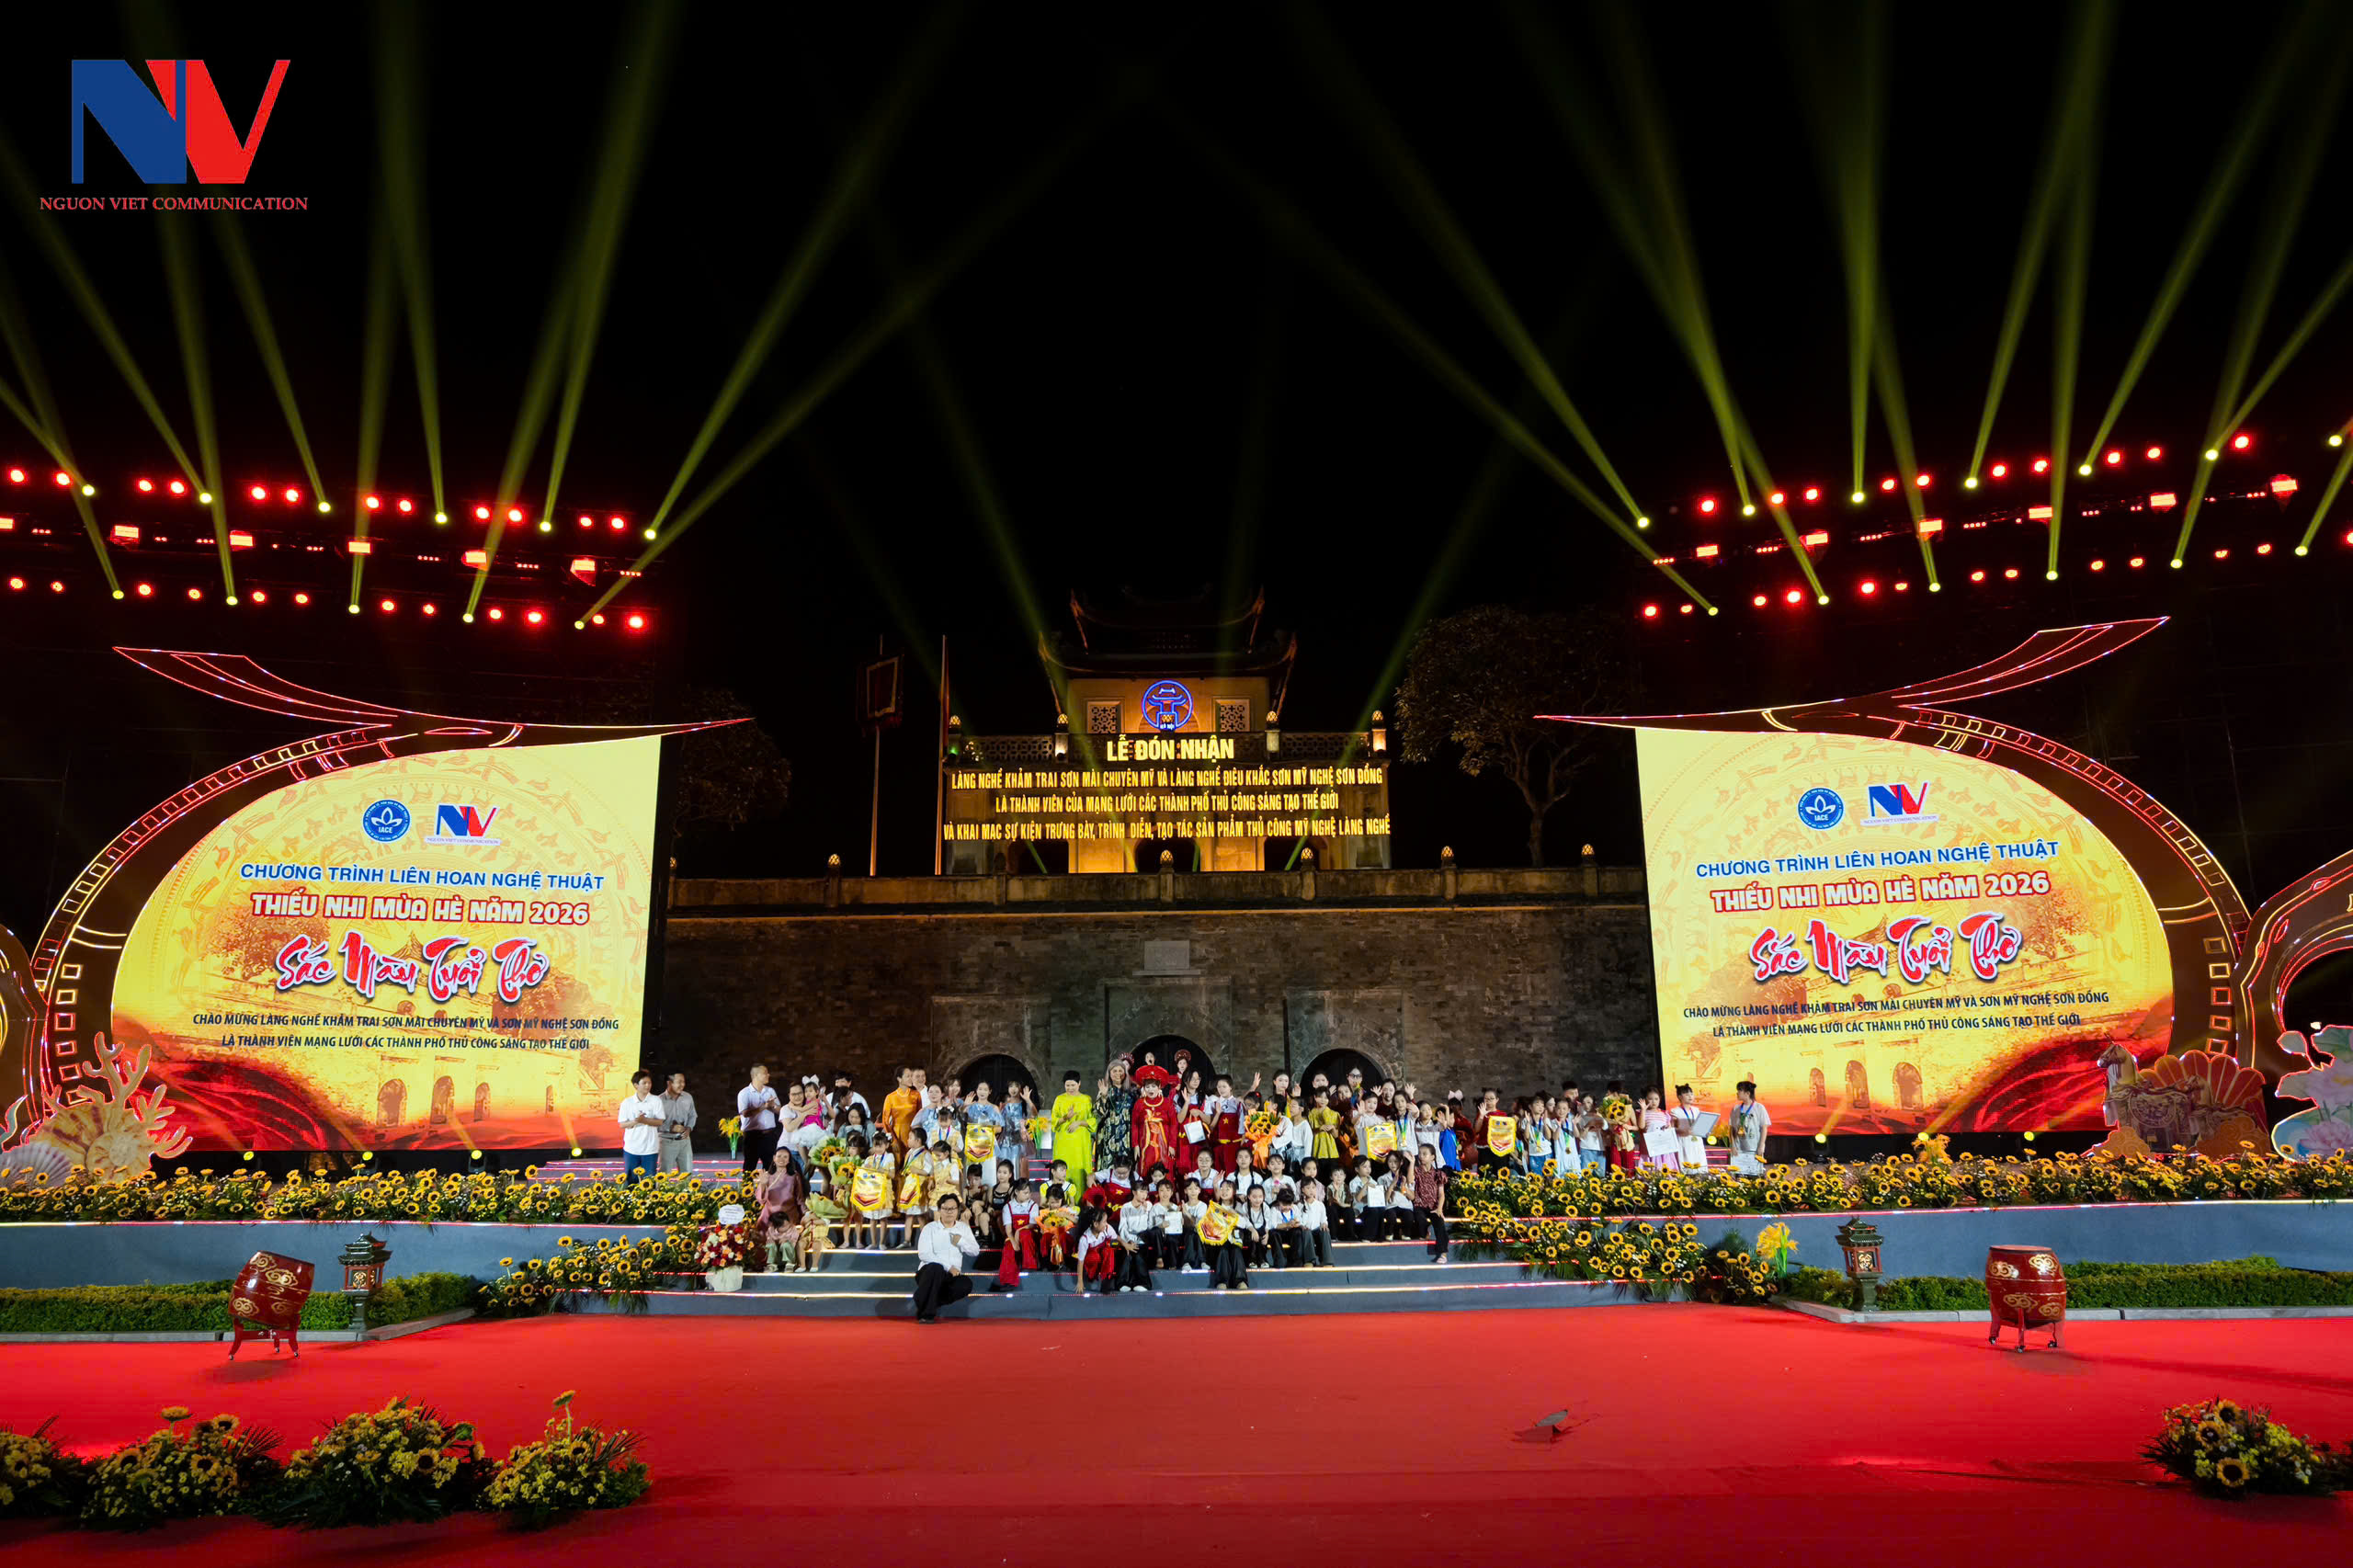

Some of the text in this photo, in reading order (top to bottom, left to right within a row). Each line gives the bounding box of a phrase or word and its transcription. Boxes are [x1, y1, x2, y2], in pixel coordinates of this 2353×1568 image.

[1107, 734, 1234, 763] LỄ ĐÓN NHẬN
[952, 763, 1382, 789] LÀNG NGHỀ KHẢM TRAI SƠN MÀI CHUYÊN MỸ VÀ LÀNG NGHỀ ĐIÊU KHẮC SƠN MỸ NGHỆ SƠN ĐỒNG
[996, 788, 1338, 814] LÀ THÀNH VIÊN CỦA MẠNG LƯỚI CÁC THÀNH PHỐ THỦ CÔNG SÁNG TẠO THẾ GIỚI
[1869, 782, 1927, 816] NV
[437, 805, 497, 836] NV
[944, 821, 954, 840] VÀ
[957, 824, 979, 840] KHAI
[1005, 822, 1018, 842] SỰ
[1020, 821, 1041, 842] KIỆN
[1046, 823, 1075, 840] TRƯNG
[1078, 820, 1096, 840] BÀY,
[1098, 820, 1125, 839] TRÌNH
[1130, 817, 1154, 839] DIỄN,
[1157, 822, 1173, 841] TẠO
[1176, 819, 1193, 838] TÁC
[1196, 816, 1214, 837] SẢN
[1218, 814, 1244, 837] PHẨM
[1246, 816, 1264, 836] THỦ
[1267, 818, 1291, 836] CÔNG
[1295, 818, 1308, 836] MỸ
[1313, 816, 1336, 837] NGHỆ
[1339, 816, 1363, 835] LÀNG
[1366, 813, 1390, 835] NGHỀ
[1696, 839, 2059, 877] CHƯƠNG TRÌNH LIÊN HOAN NGHỆ THUẬT
[241, 863, 604, 892] CHƯƠNG TRÌNH LIÊN HOAN NGHỆ THUẬT
[1711, 871, 2051, 913] THIẾU NHI MÙA HÈ NĂM 2026
[251, 887, 589, 925] THIẾU NHI MÙA HÈ NĂM 2026
[277, 934, 336, 989] Sắc
[1750, 926, 1808, 981] Sắc
[1684, 990, 2109, 1017] CHÀO MỪNG LÀNG NGHỀ KHẢM TRAI SƠN MÀI CHUYÊN MỸ VÀ SƠN MỸ NGHỆ SƠN ĐỒNG
[193, 1013, 619, 1031] CHÀO MỪNG LÀNG NGHỀ KHẢM TRAI SƠN MÀI CHUYÊN MỸ VÀ SƠN MỸ NGHỆ SƠN ĐỒNG
[1713, 1012, 2081, 1037] LÀ THÀNH VIÊN MẠNG LƯỚI CÁC THÀNH PHỐ THỦ CÔNG SÁNG TẠO THẾ GIỚI
[222, 1034, 589, 1051] LÀ THÀNH VIÊN MẠNG LƯỚI CÁC THÀNH PHỐ THỦ CÔNG SÁNG TẠO THẾ GIỚI
